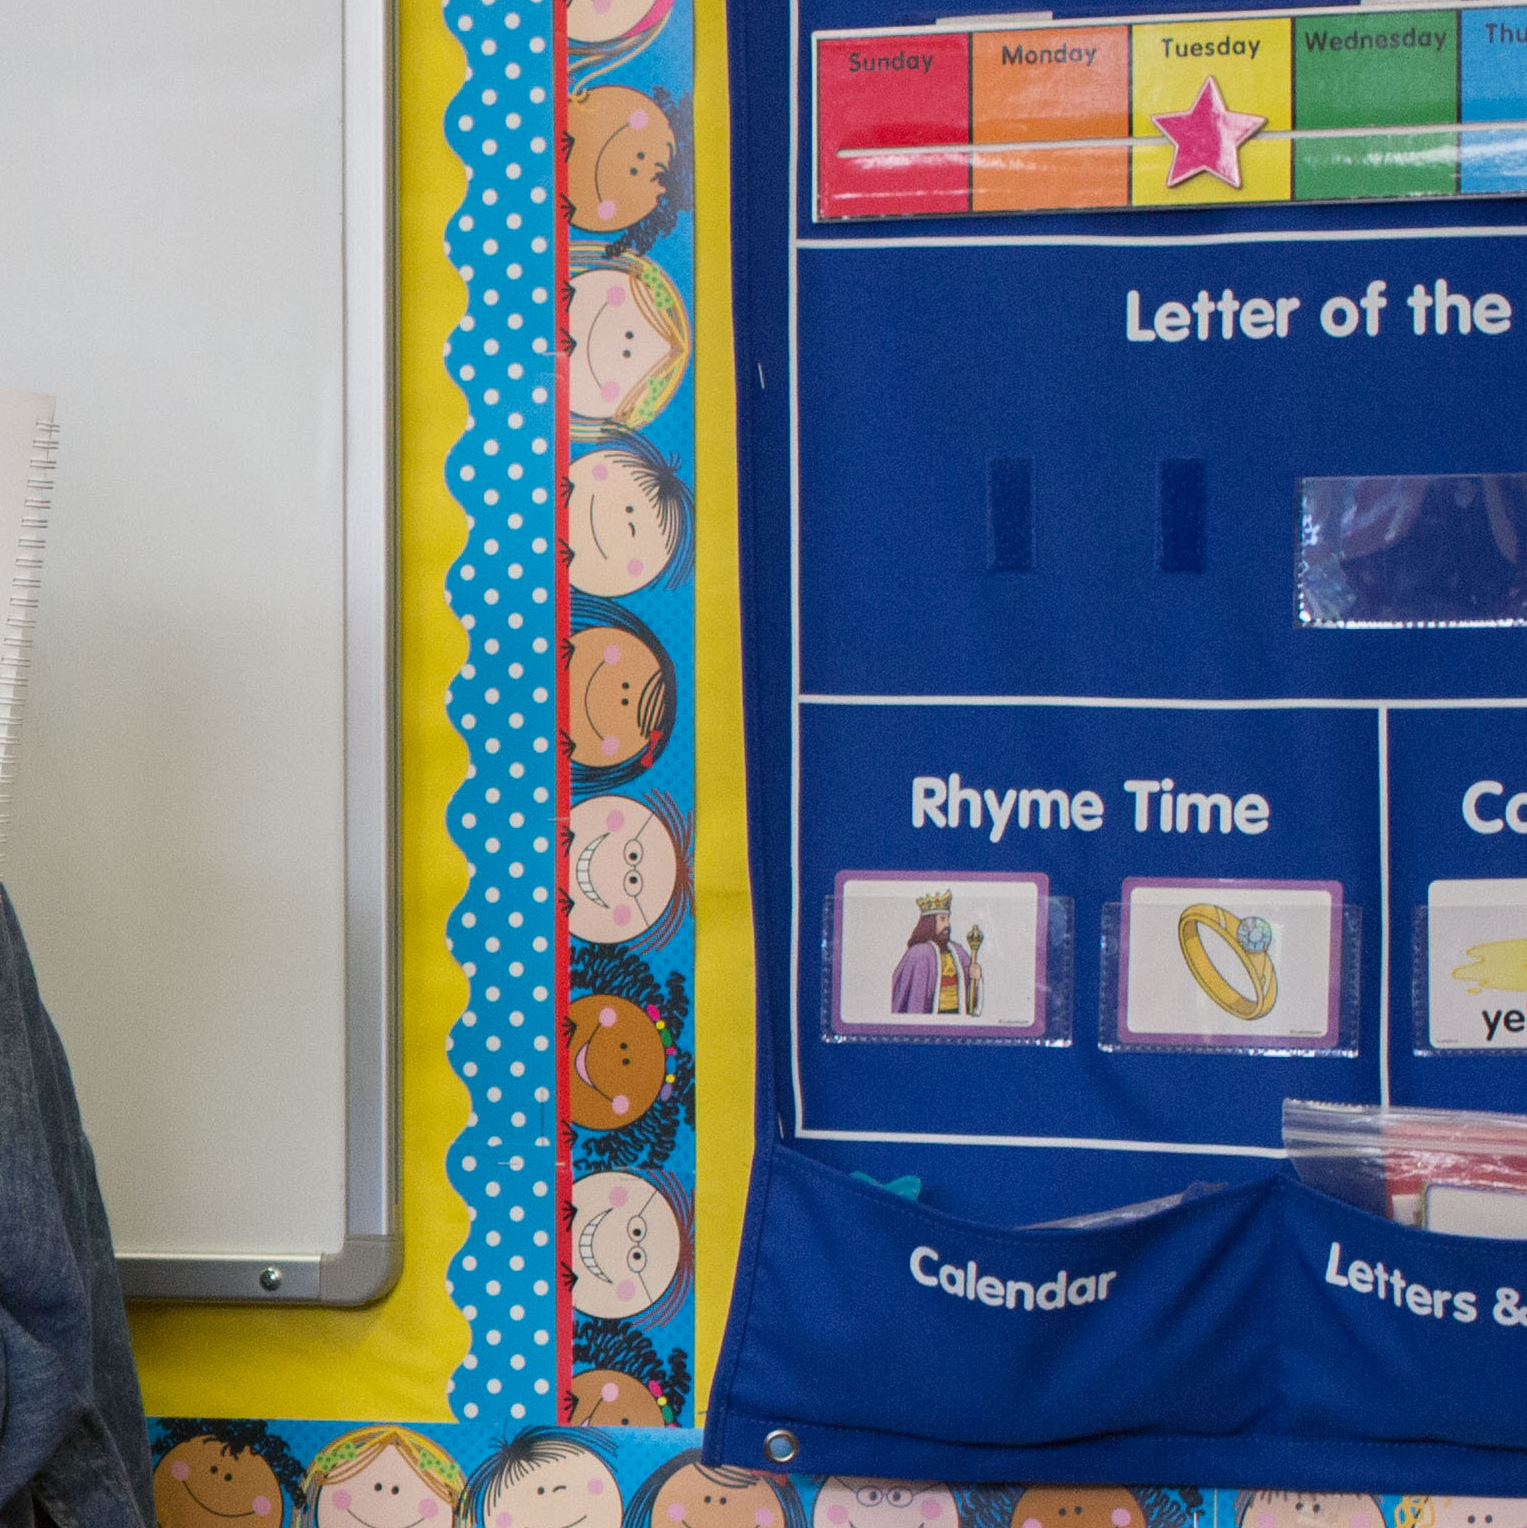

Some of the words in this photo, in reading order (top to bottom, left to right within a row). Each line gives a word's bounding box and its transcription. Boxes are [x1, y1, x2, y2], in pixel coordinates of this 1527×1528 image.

[1001, 43, 1098, 66] Monday
[1160, 36, 1261, 60] Tuesday
[1304, 26, 1447, 55] Wednesday
[848, 49, 934, 75] Sunday
[1127, 288, 1301, 342] Letter
[1320, 280, 1388, 337] of
[1407, 278, 1512, 335] the
[911, 773, 1105, 843] Rhyme
[1124, 777, 1270, 835] Time
[1481, 1009, 1526, 1042] ye
[909, 1246, 1117, 1311] Calendar
[1325, 1242, 1478, 1323] Letters
